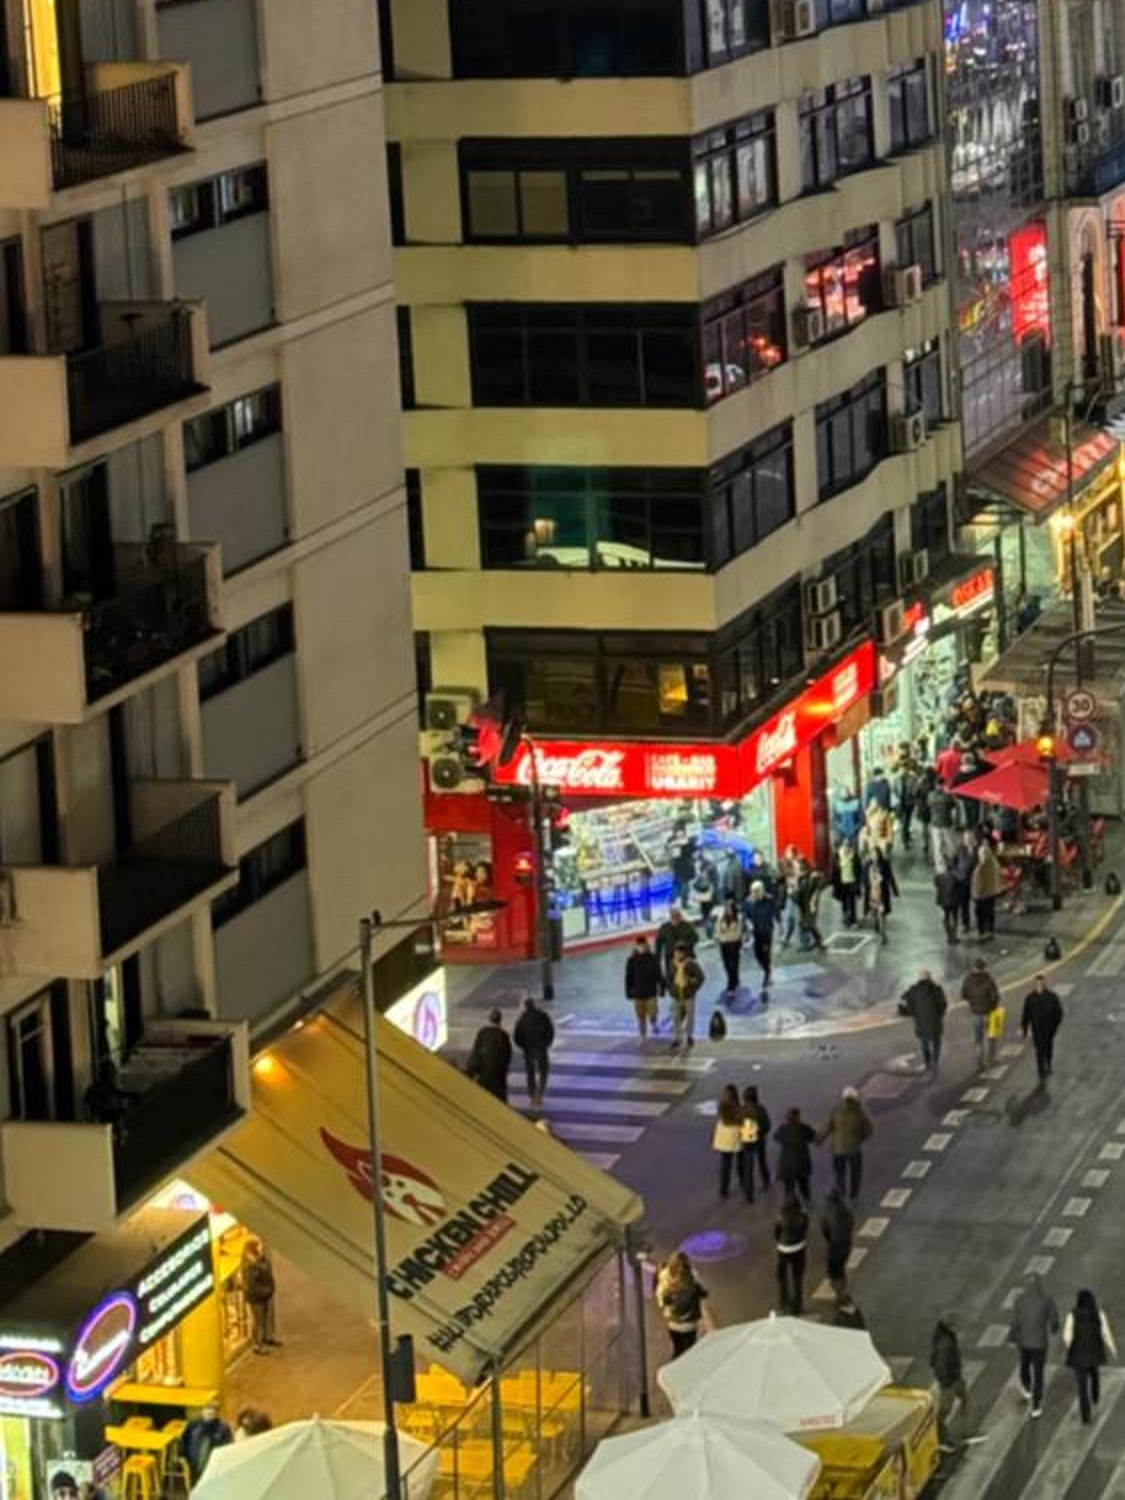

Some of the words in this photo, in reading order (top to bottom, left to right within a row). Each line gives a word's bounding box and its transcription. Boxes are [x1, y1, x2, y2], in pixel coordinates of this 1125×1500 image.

[1071, 697, 1091, 713] 30
[516, 748, 625, 788] Coca-Cola
[385, 1210, 485, 1300] CHICKEN
[469, 1162, 540, 1219] CHILL
